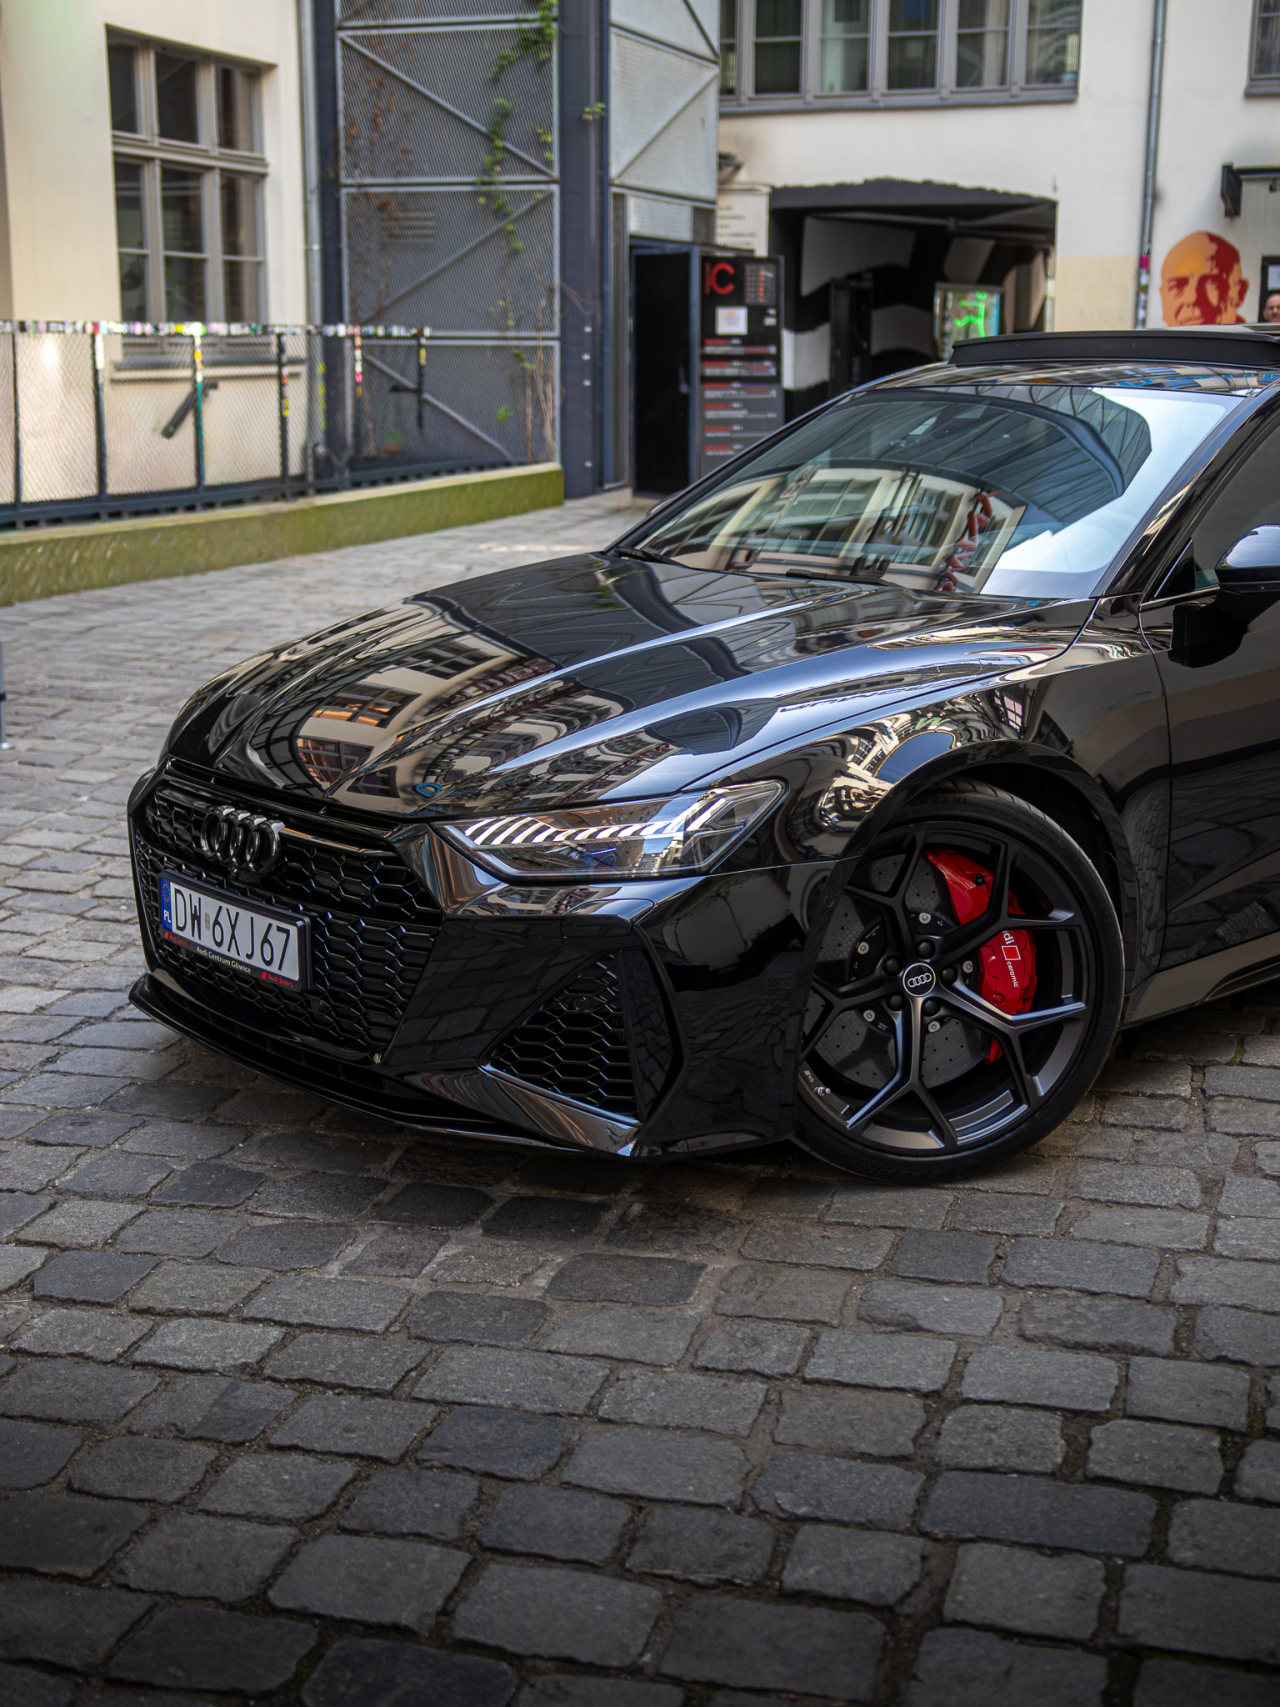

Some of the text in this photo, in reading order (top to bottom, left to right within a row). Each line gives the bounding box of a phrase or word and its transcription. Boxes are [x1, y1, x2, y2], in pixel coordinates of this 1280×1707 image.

[163, 909, 172, 923] PL
[174, 887, 291, 972] DW 6XJ67
[196, 946, 252, 974] Audi Centrum Gliwice
[267, 974, 293, 988] Audi Sport
[1006, 961, 1019, 988] ceramic
